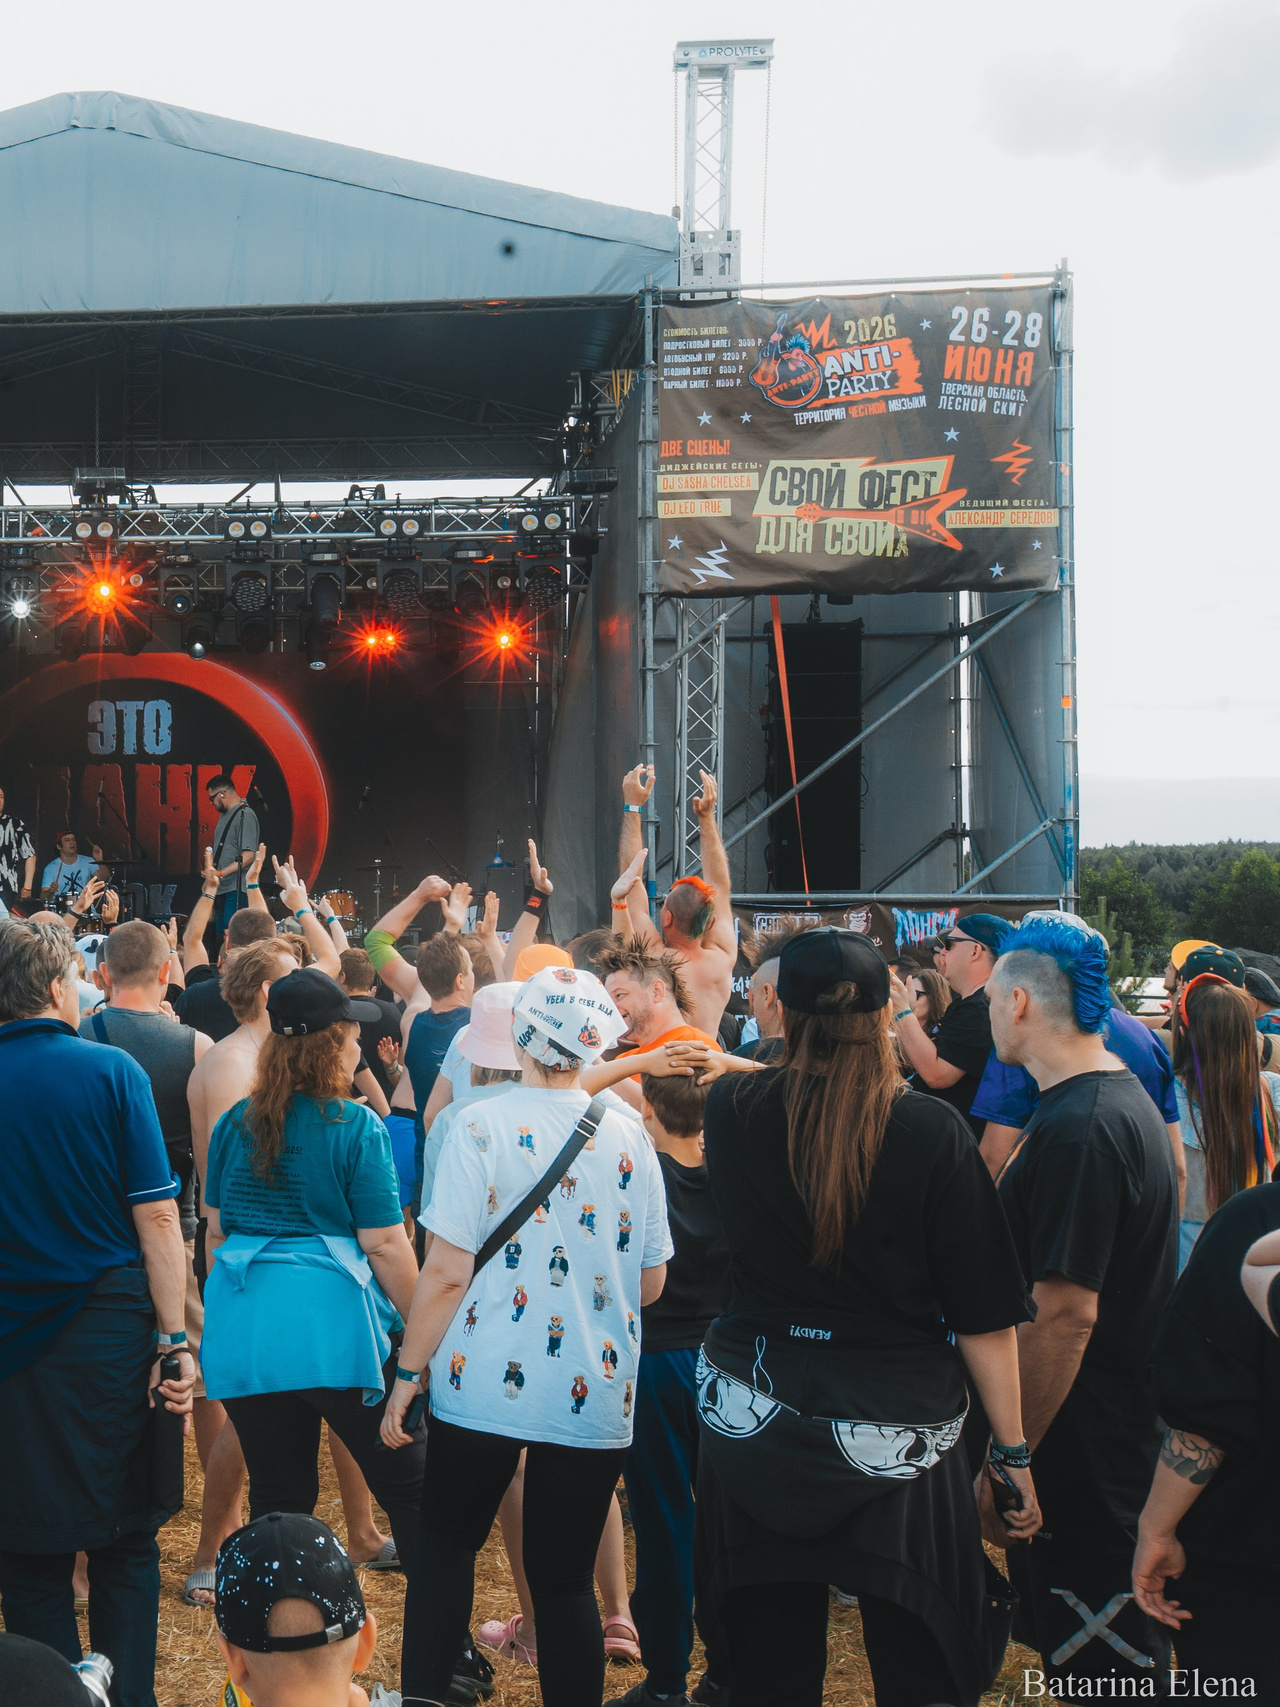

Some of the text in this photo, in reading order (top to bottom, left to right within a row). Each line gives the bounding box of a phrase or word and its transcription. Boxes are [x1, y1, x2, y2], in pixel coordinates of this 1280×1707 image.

[709, 46, 758, 56] PROLYTE
[663, 327, 698, 337] СТОИМОСТЬ
[844, 313, 897, 345] 2026
[663, 339, 709, 350] ПОДРОСТКОВЫЙ
[711, 339, 731, 348] БИЛЕТ
[738, 338, 755, 347] 3000
[664, 352, 702, 363] АВТОБУСНЫЙ
[705, 353, 715, 361] ТУР
[722, 352, 740, 360] 3200
[824, 344, 901, 378] ANTI-
[693, 366, 712, 375] БИЛЕТ
[719, 365, 736, 374] 6000
[944, 345, 1034, 387] ИЮНЯ
[663, 379, 687, 389] ПАРНЫЙ
[690, 379, 709, 388] БИЛЕТ
[826, 370, 892, 399] PARTY
[941, 382, 984, 397] ТВЕРСКАЯ
[793, 395, 926, 426] ТЕРРИТОРИЯ ЧЕСТНОЙ МУЗЫКИ
[938, 396, 1024, 417] ЛЕСНОЙ СКИТ
[660, 439, 730, 457] ДВЕ СЦЕНЫ!
[660, 462, 728, 472] ДИДЖЕЙСКИЕ
[662, 475, 751, 490] DJ SASHA CHELSEA
[769, 462, 937, 509] СВОЙ ФЕСТ
[664, 501, 722, 515] DJ LEO TRUE
[960, 499, 1008, 507] ВЕДУЩИЙ
[948, 511, 1056, 525] АЛЕКСАНДР СЕРЕДОВ!
[756, 516, 814, 554] ДЛЯ
[87, 699, 172, 755] ЭТО
[546, 994, 613, 1017] УБЕЙ В СЕБЕ ДЕДА
[790, 1325, 832, 1341] READY!
